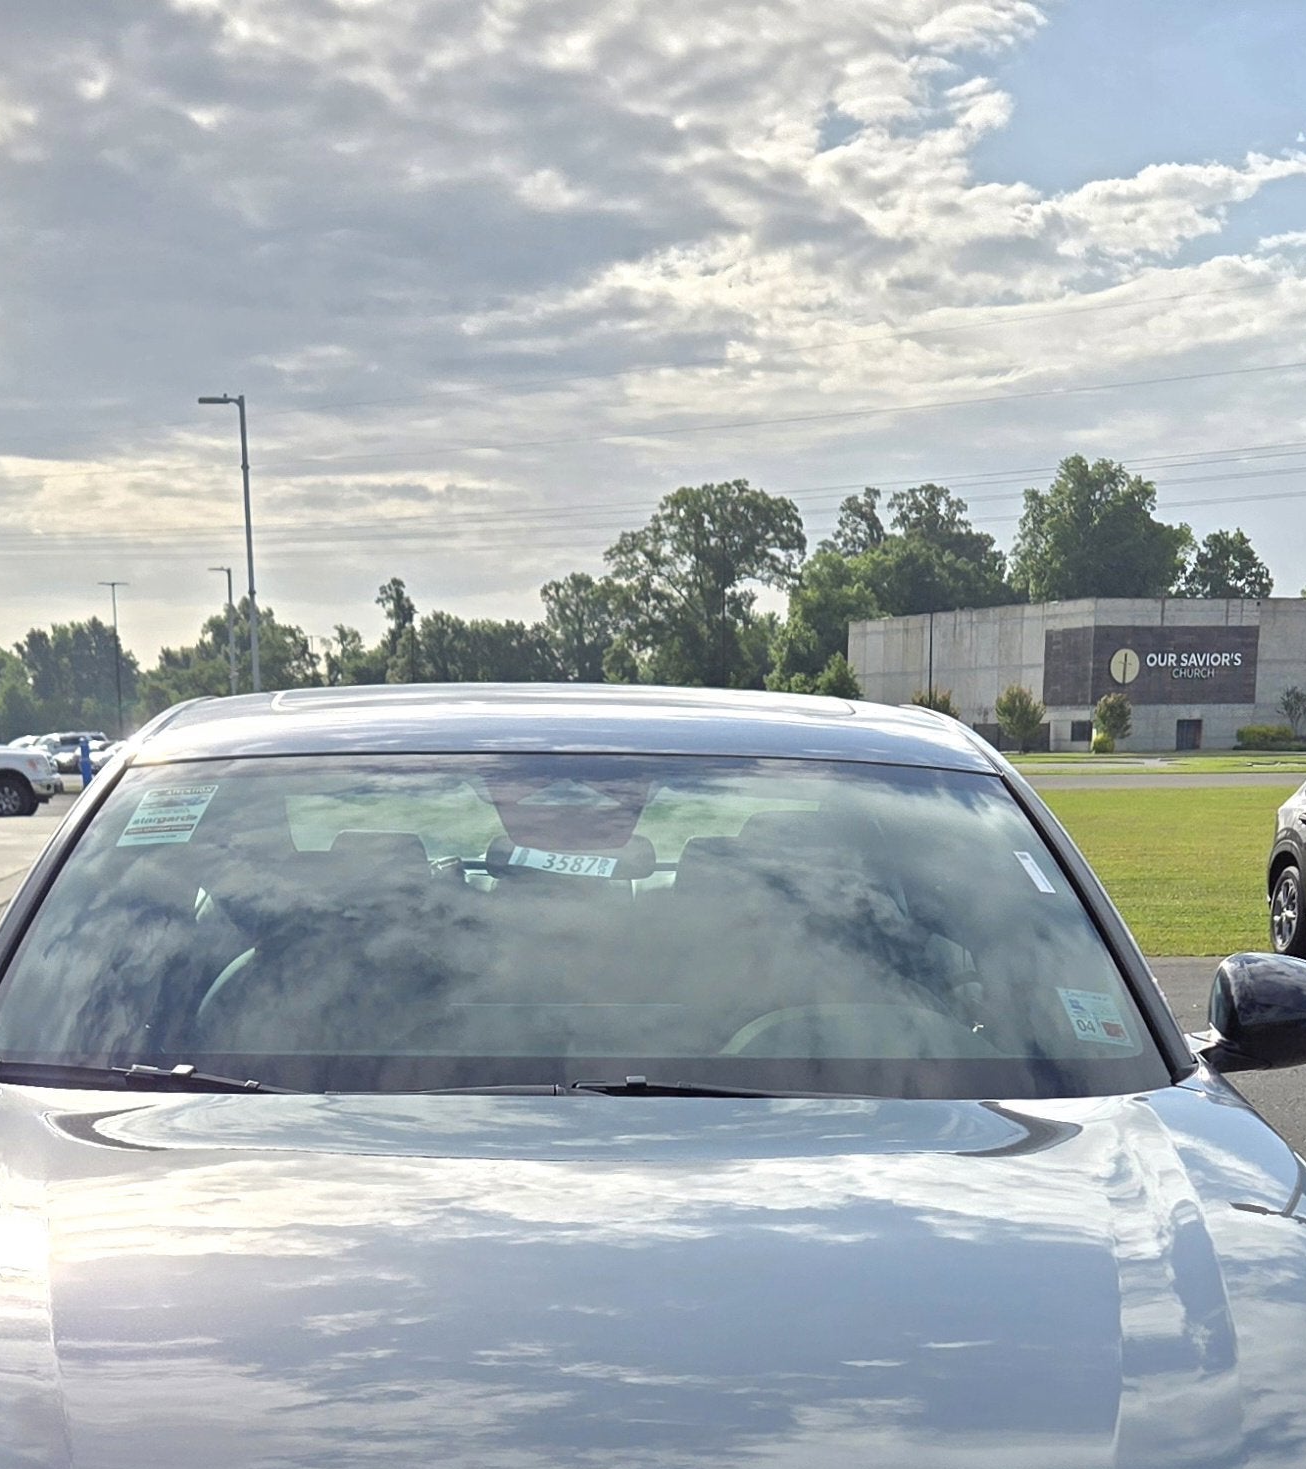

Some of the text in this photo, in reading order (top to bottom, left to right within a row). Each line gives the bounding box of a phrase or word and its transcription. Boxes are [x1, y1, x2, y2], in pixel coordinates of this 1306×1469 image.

[1146, 653, 1242, 667] OUR SAVIOR'S
[1172, 668, 1215, 679] CHURCH
